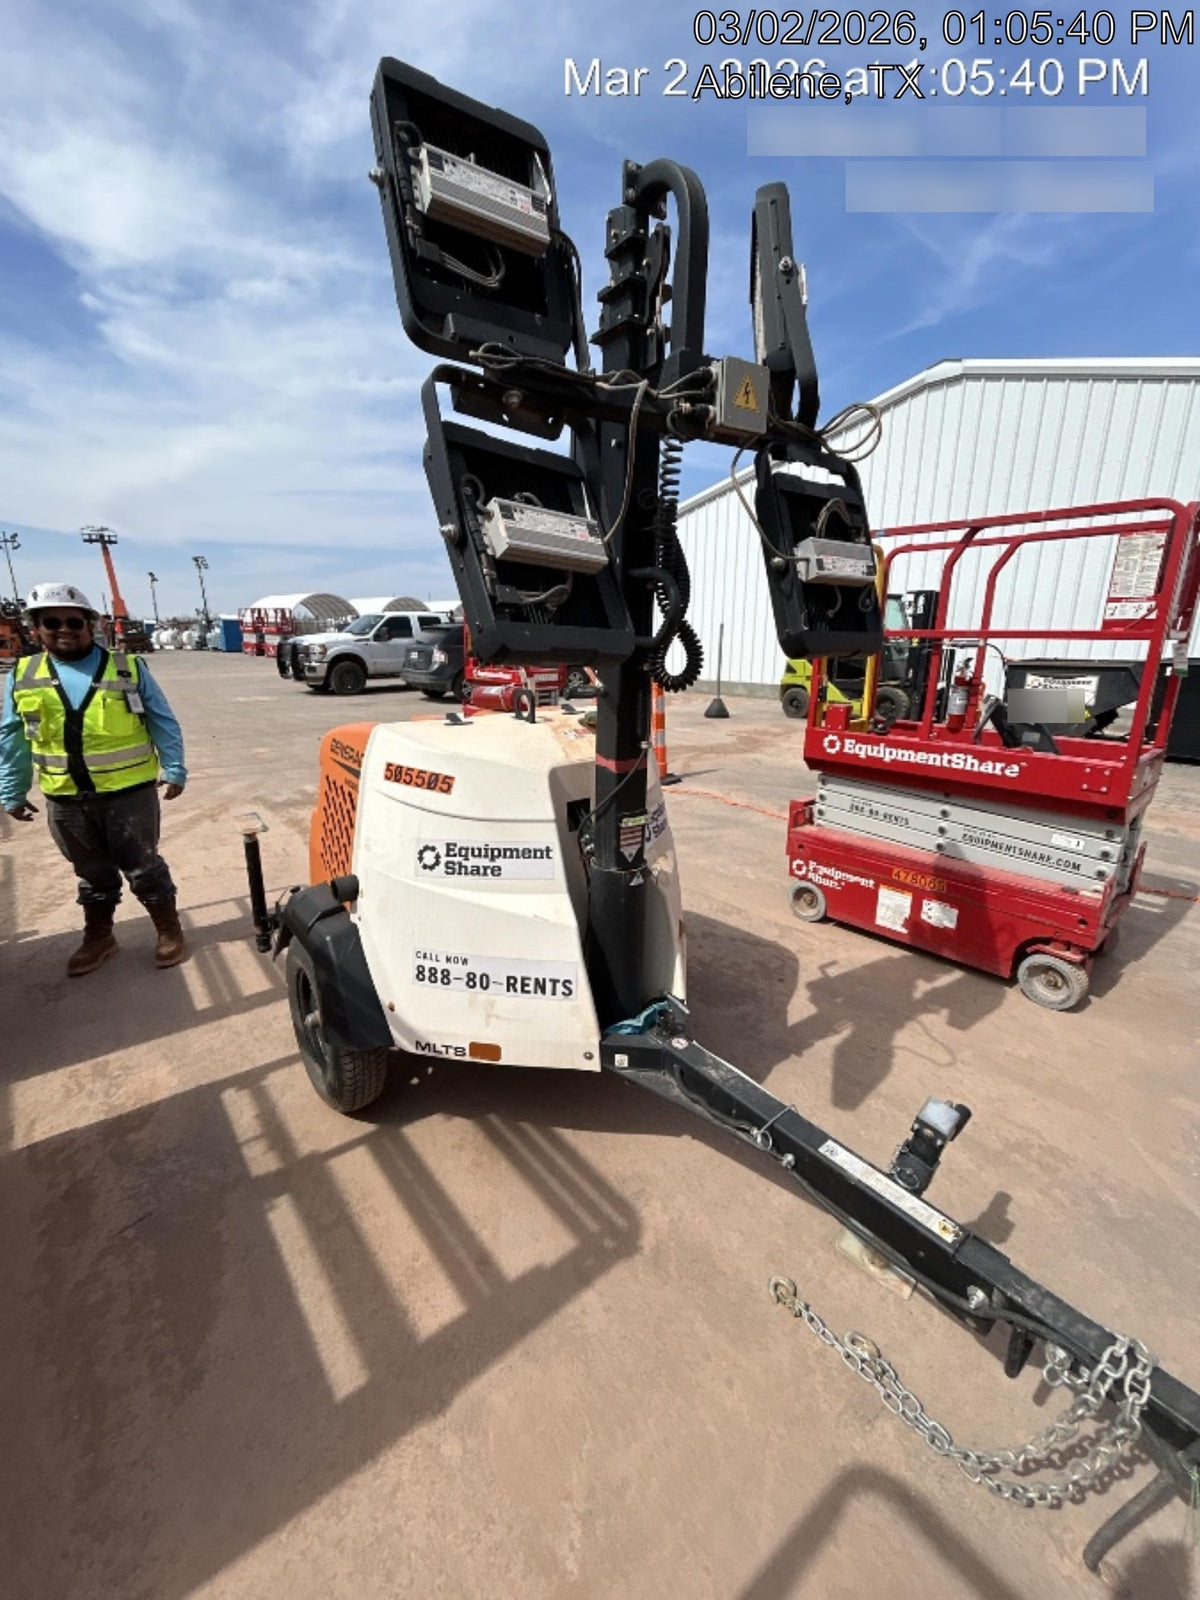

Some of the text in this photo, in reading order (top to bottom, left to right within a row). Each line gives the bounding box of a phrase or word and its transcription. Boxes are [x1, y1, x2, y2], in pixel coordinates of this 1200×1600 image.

[843, 738, 1021, 778] EquipmentShare
[384, 762, 454, 794] 505505
[444, 842, 554, 862] Equipment
[444, 860, 502, 877] Share
[415, 950, 469, 966] CALL NOW
[415, 964, 574, 997] 888-80-RENTS
[415, 1040, 467, 1057] MLT8
